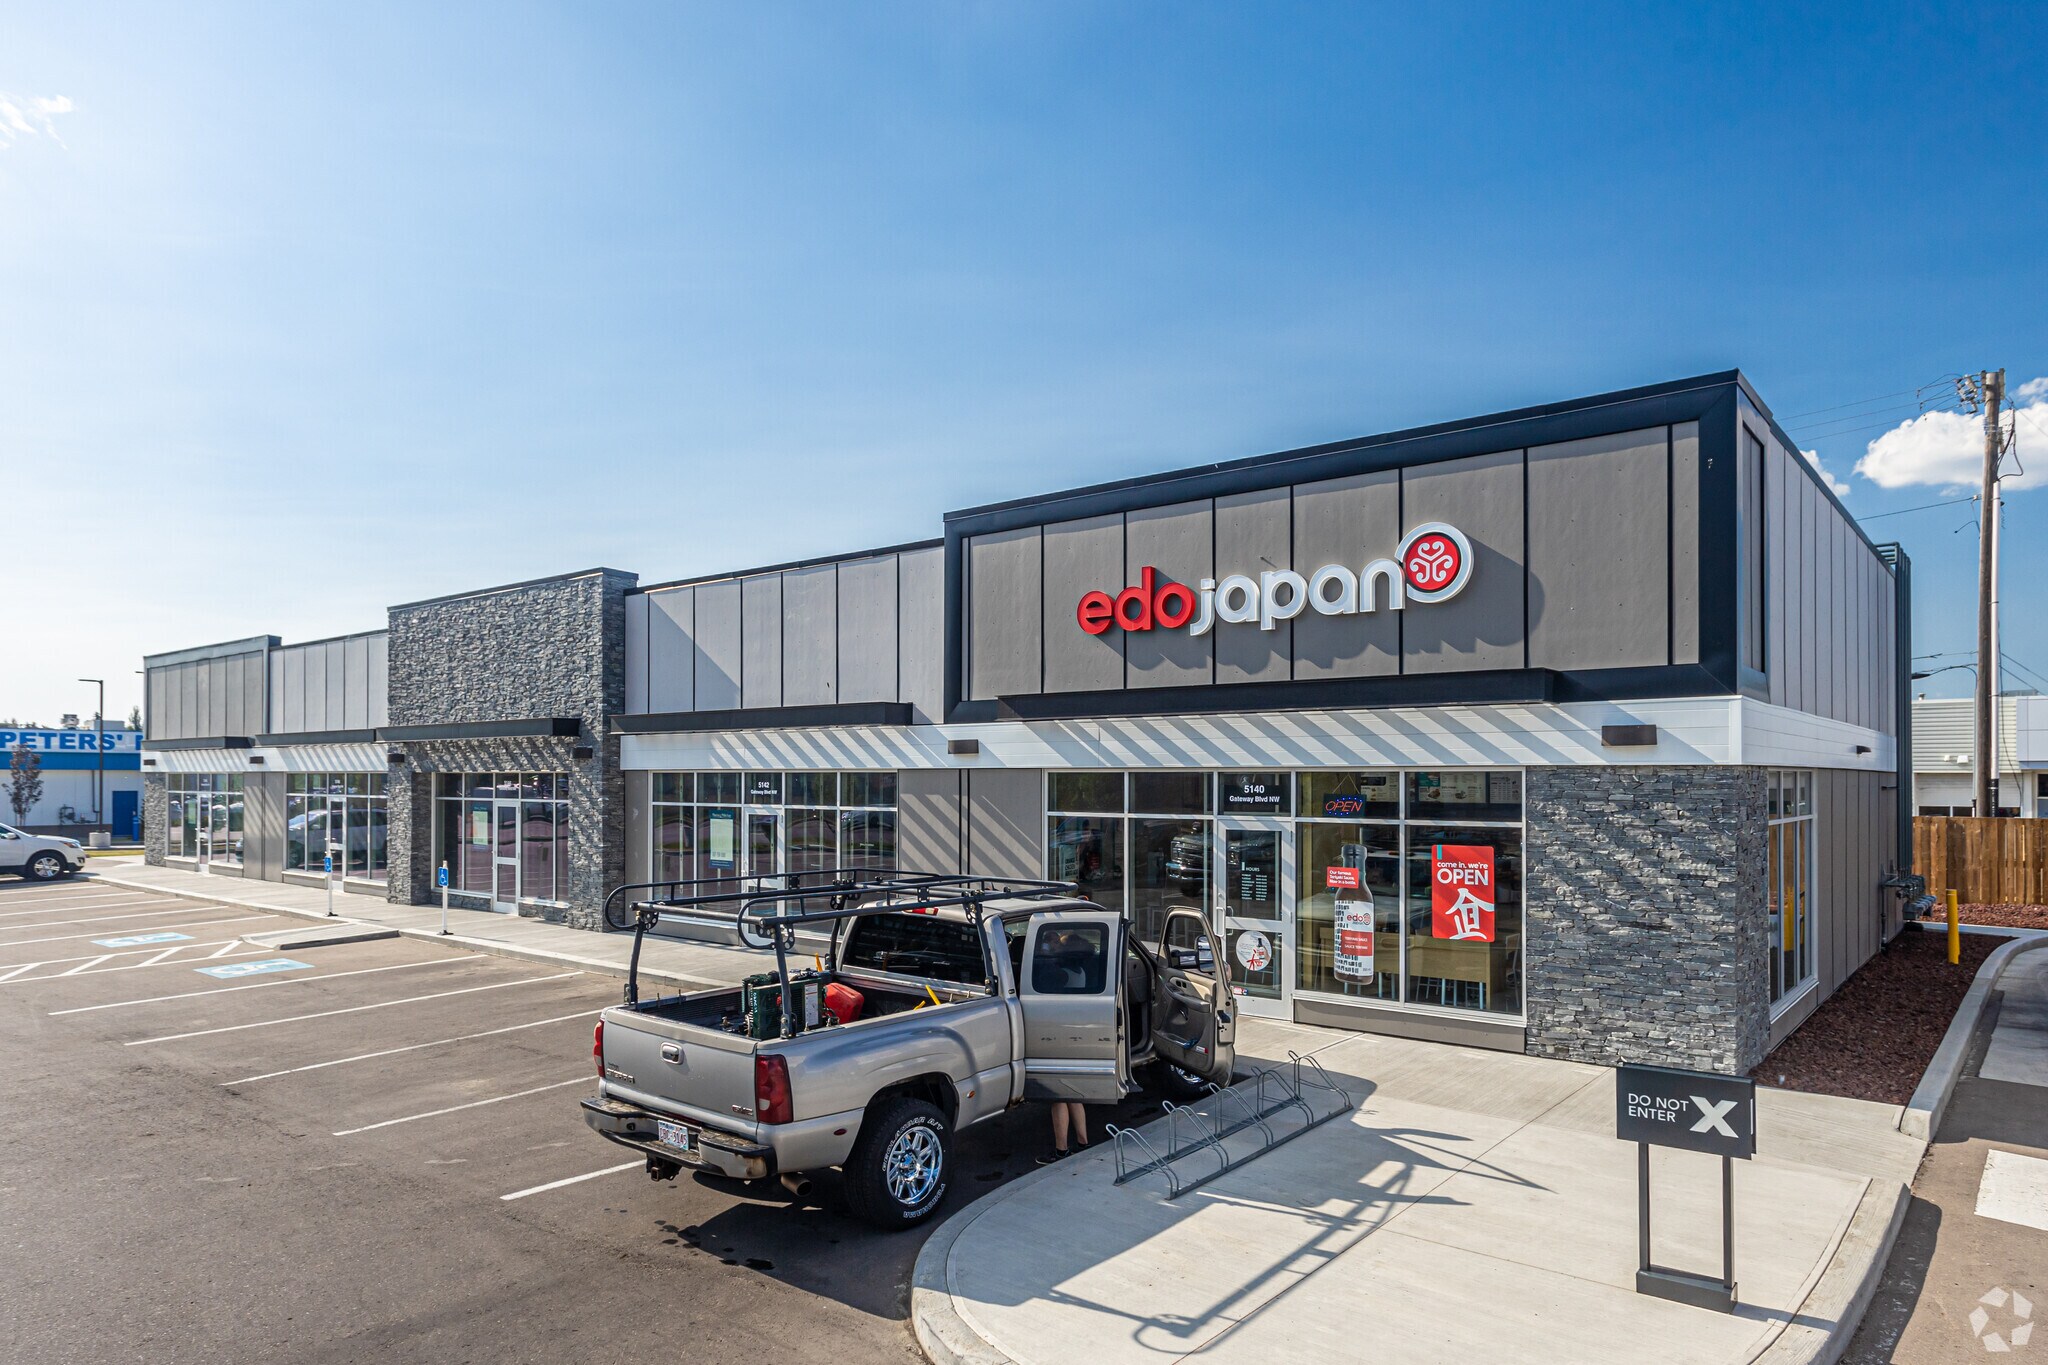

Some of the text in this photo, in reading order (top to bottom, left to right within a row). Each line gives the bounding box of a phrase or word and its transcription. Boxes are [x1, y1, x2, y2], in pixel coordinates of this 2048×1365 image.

[0, 731, 122, 750] PETERS'
[1244, 785, 1265, 793] 5140
[1229, 795, 1254, 803] Gateway
[1325, 801, 1362, 812] OPEN
[1437, 868, 1488, 885] OPEN
[1347, 913, 1363, 922] edo
[1628, 1093, 1651, 1107] DO
[1656, 1096, 1689, 1111] NOT
[1628, 1105, 1676, 1122] ENTER
